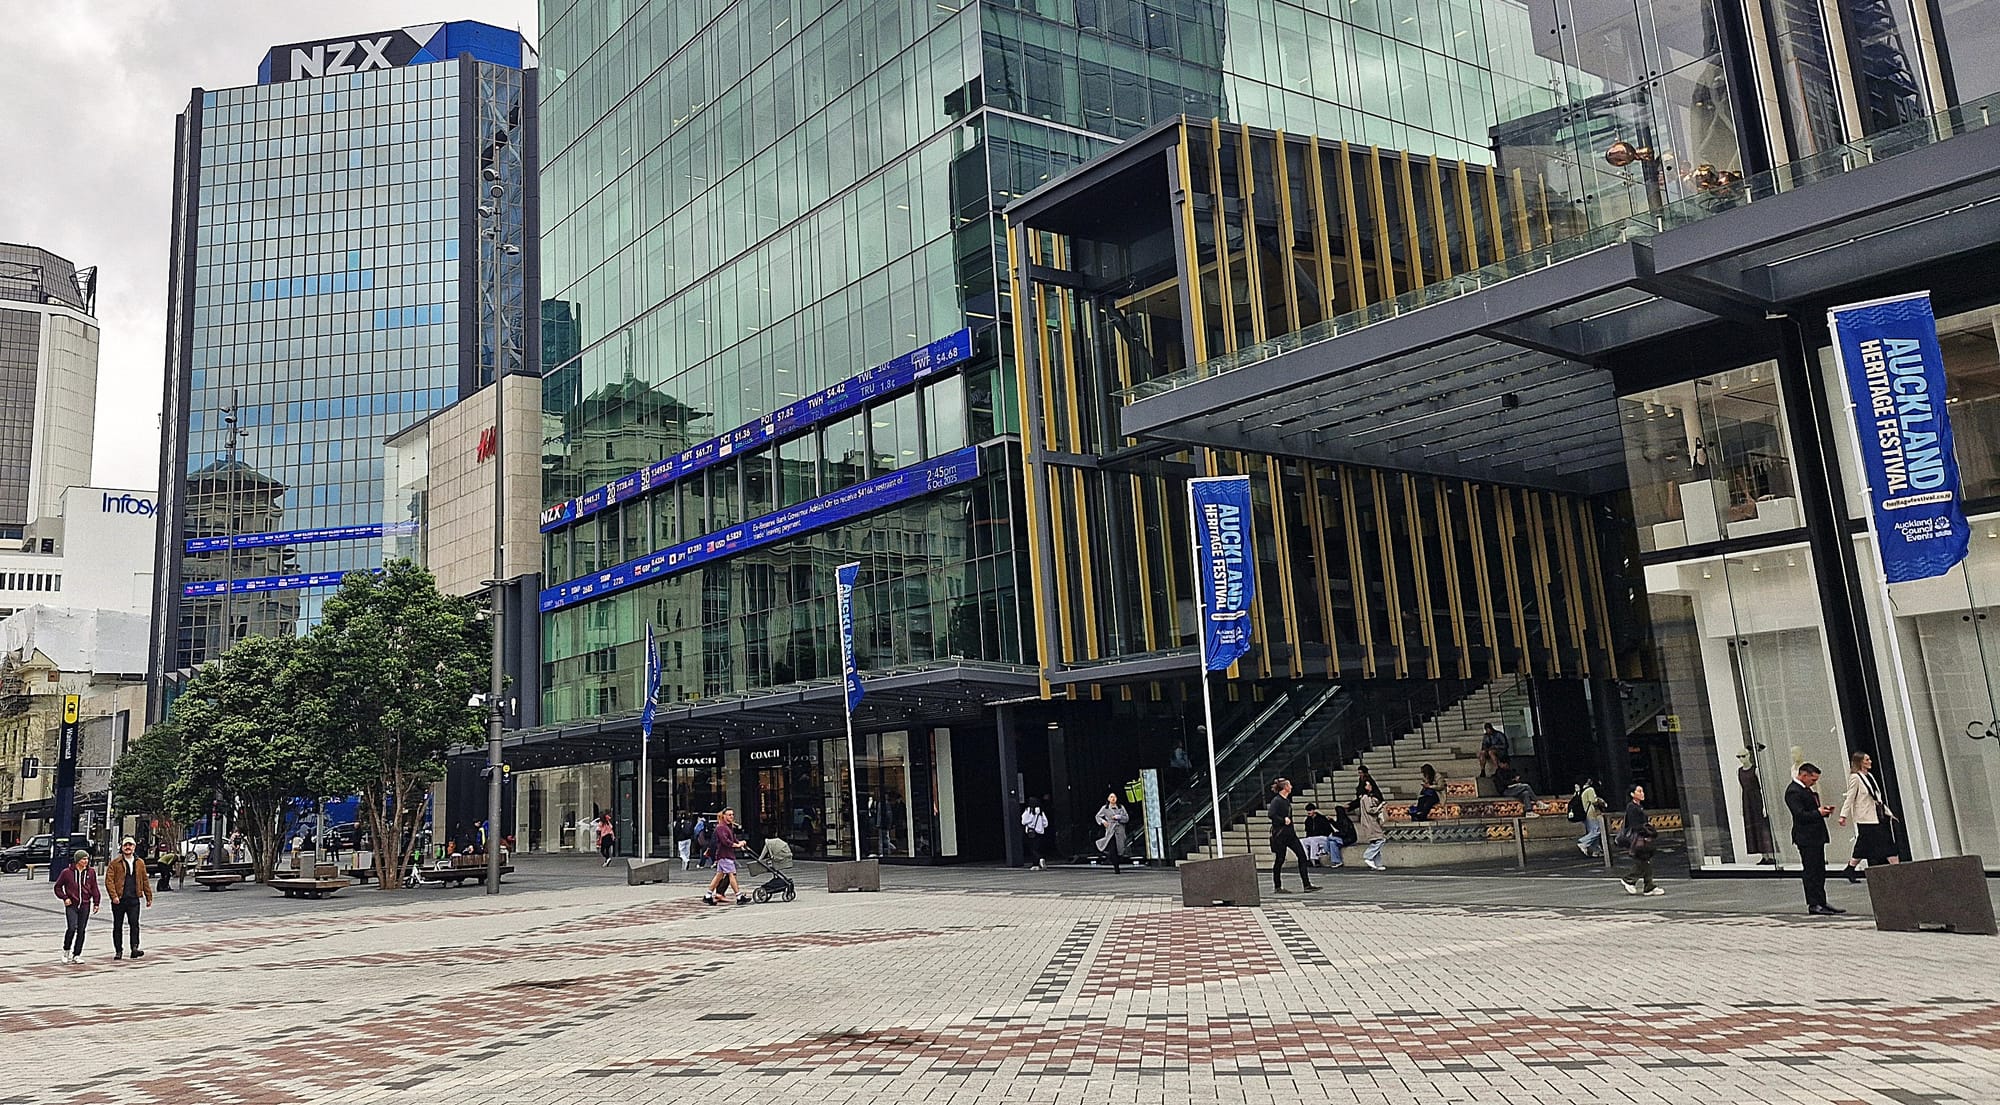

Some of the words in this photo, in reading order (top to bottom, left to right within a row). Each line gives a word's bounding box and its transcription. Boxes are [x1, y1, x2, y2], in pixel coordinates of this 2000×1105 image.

[290, 36, 394, 81] NZX
[1860, 338, 1895, 418] HERITAGE
[807, 395, 824, 410] TWH
[761, 413, 773, 426] POT
[1882, 338, 1946, 491] AUCKLAND
[720, 433, 731, 446] PCT
[1875, 419, 1908, 496] FESTIVAL
[926, 465, 957, 482] 2:45pm
[932, 480, 943, 489] Oct
[943, 475, 958, 486] 2025
[102, 492, 159, 519] Infosy
[540, 502, 565, 525] NZX
[1204, 503, 1223, 557] HERITAGE
[1894, 517, 1933, 531] Auckland
[1217, 504, 1242, 611] AUCKLAND
[1212, 558, 1228, 610] FESTIVAL
[676, 757, 717, 765] COACH
[750, 749, 780, 760] COACH
